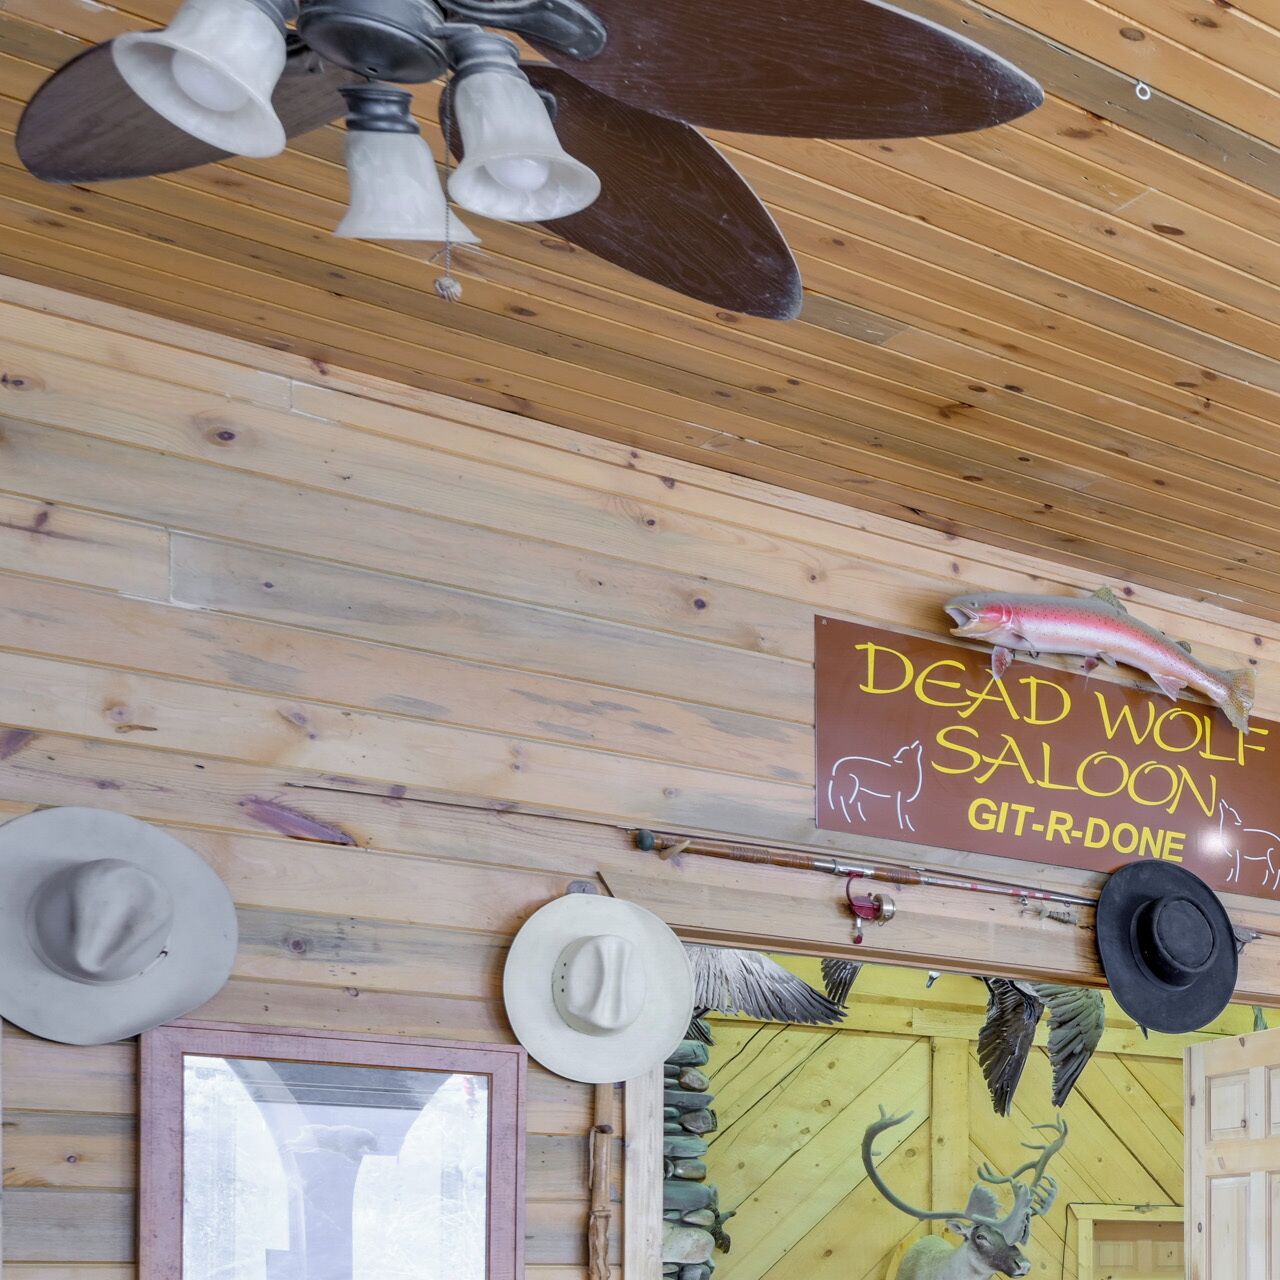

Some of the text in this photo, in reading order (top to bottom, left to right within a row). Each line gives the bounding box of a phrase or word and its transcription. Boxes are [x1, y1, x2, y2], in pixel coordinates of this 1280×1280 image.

[855, 642, 1269, 766] DEAD WOLF
[931, 725, 1217, 817] SALOON
[967, 797, 1187, 863] GIT-R-DONE
